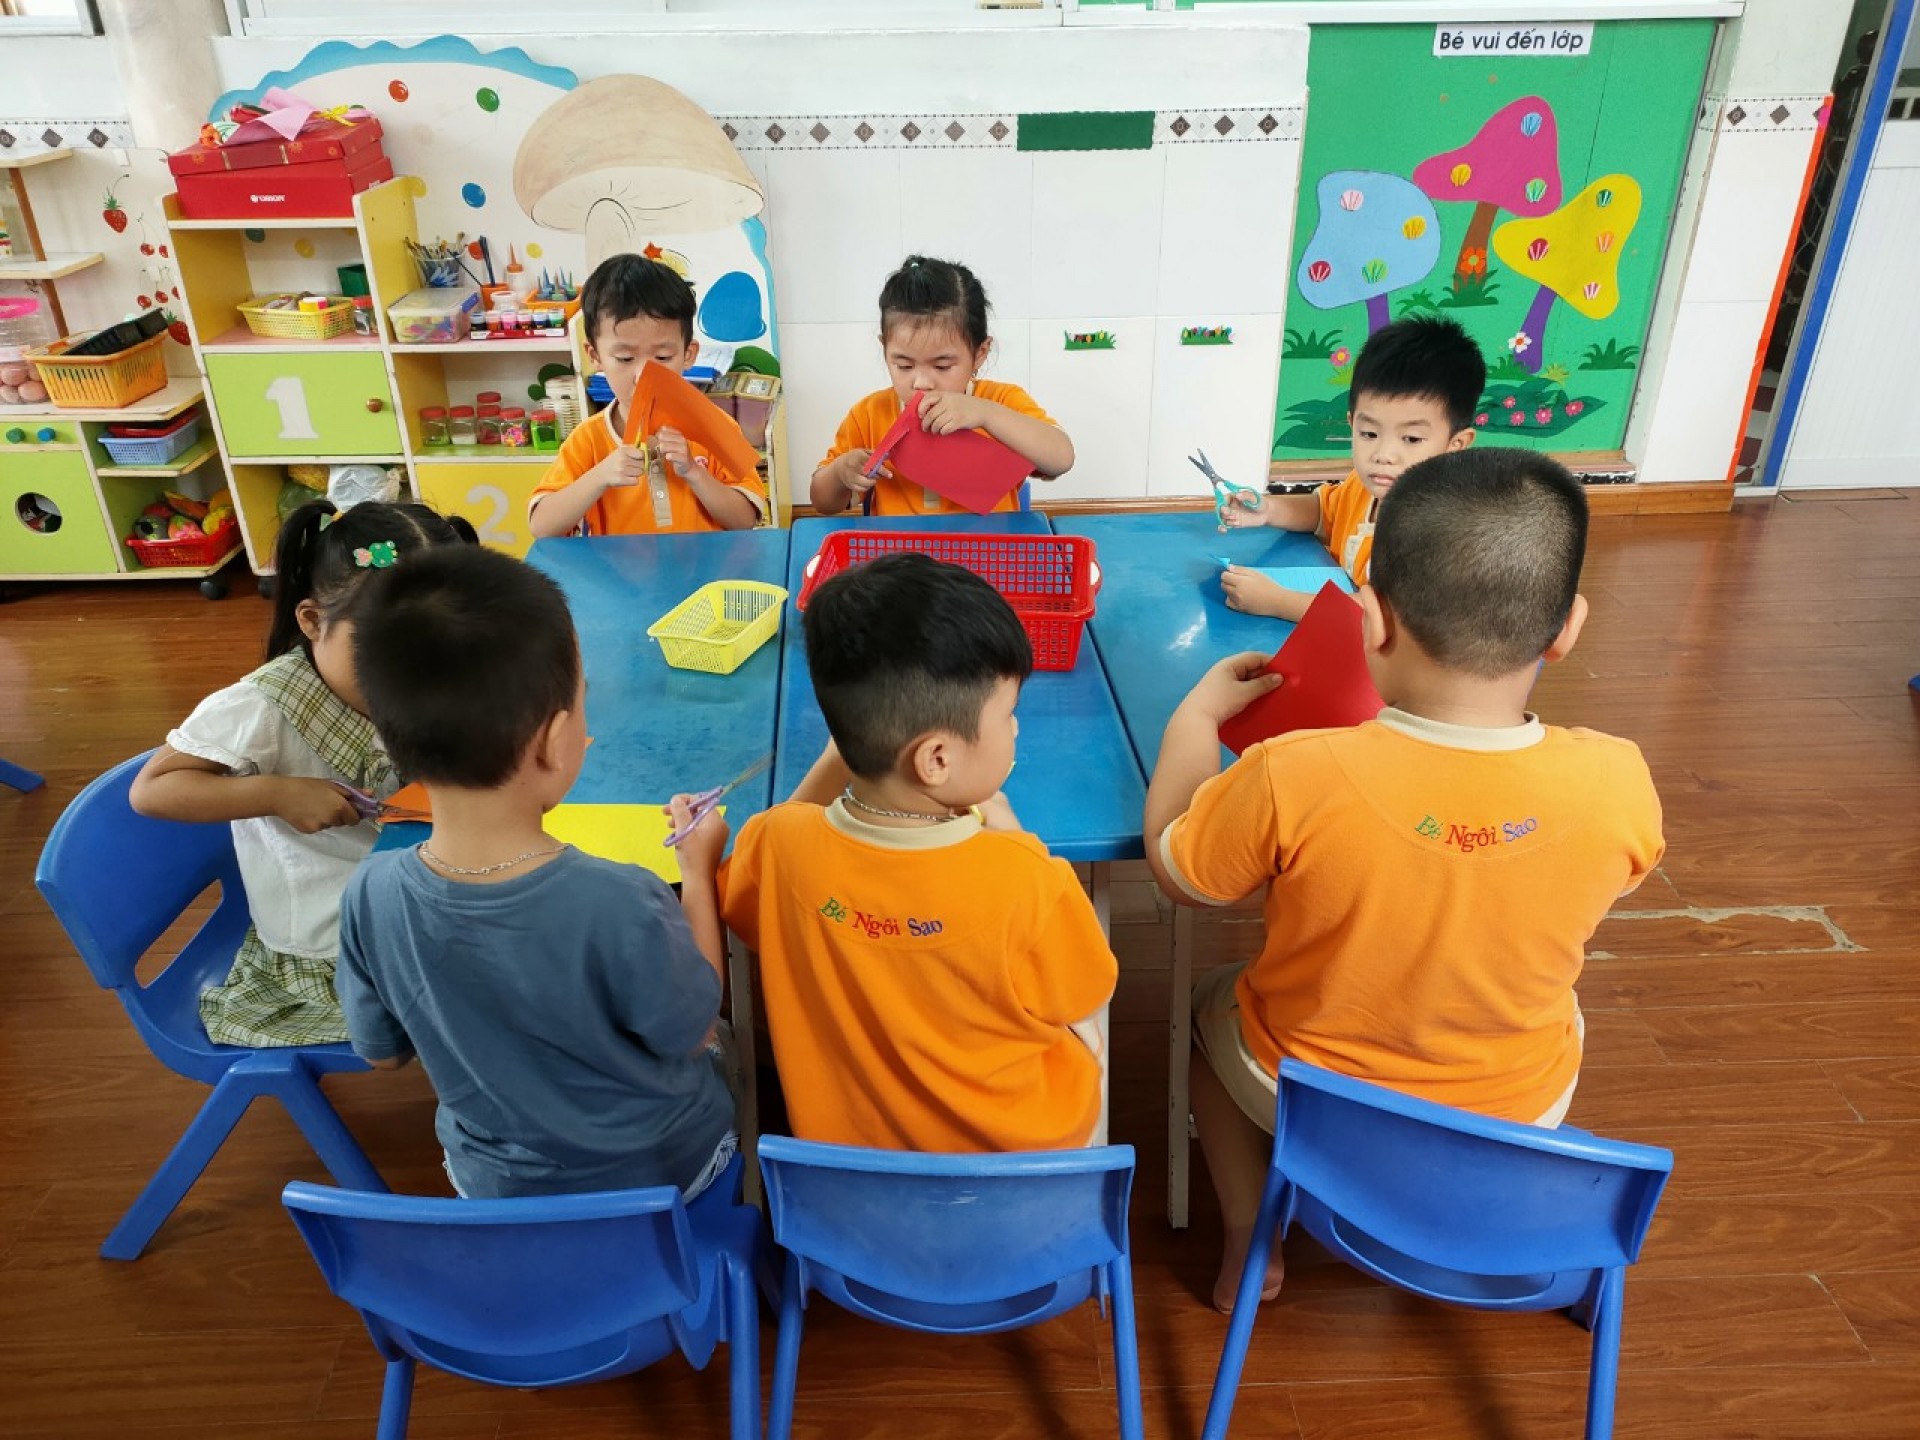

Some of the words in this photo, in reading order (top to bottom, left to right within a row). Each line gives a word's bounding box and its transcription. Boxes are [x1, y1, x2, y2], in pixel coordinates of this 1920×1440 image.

[1439, 31, 1464, 50] Bé
[1472, 31, 1500, 49] vui
[1505, 28, 1545, 49] đến
[1550, 30, 1583, 53] lớp
[265, 376, 319, 439] 1
[467, 484, 516, 545] 2
[1445, 824, 1500, 853] Ngôi
[1502, 818, 1537, 842] Sao
[820, 897, 847, 923] Bé
[852, 911, 901, 939] Ngôi
[907, 917, 943, 937] Sao
